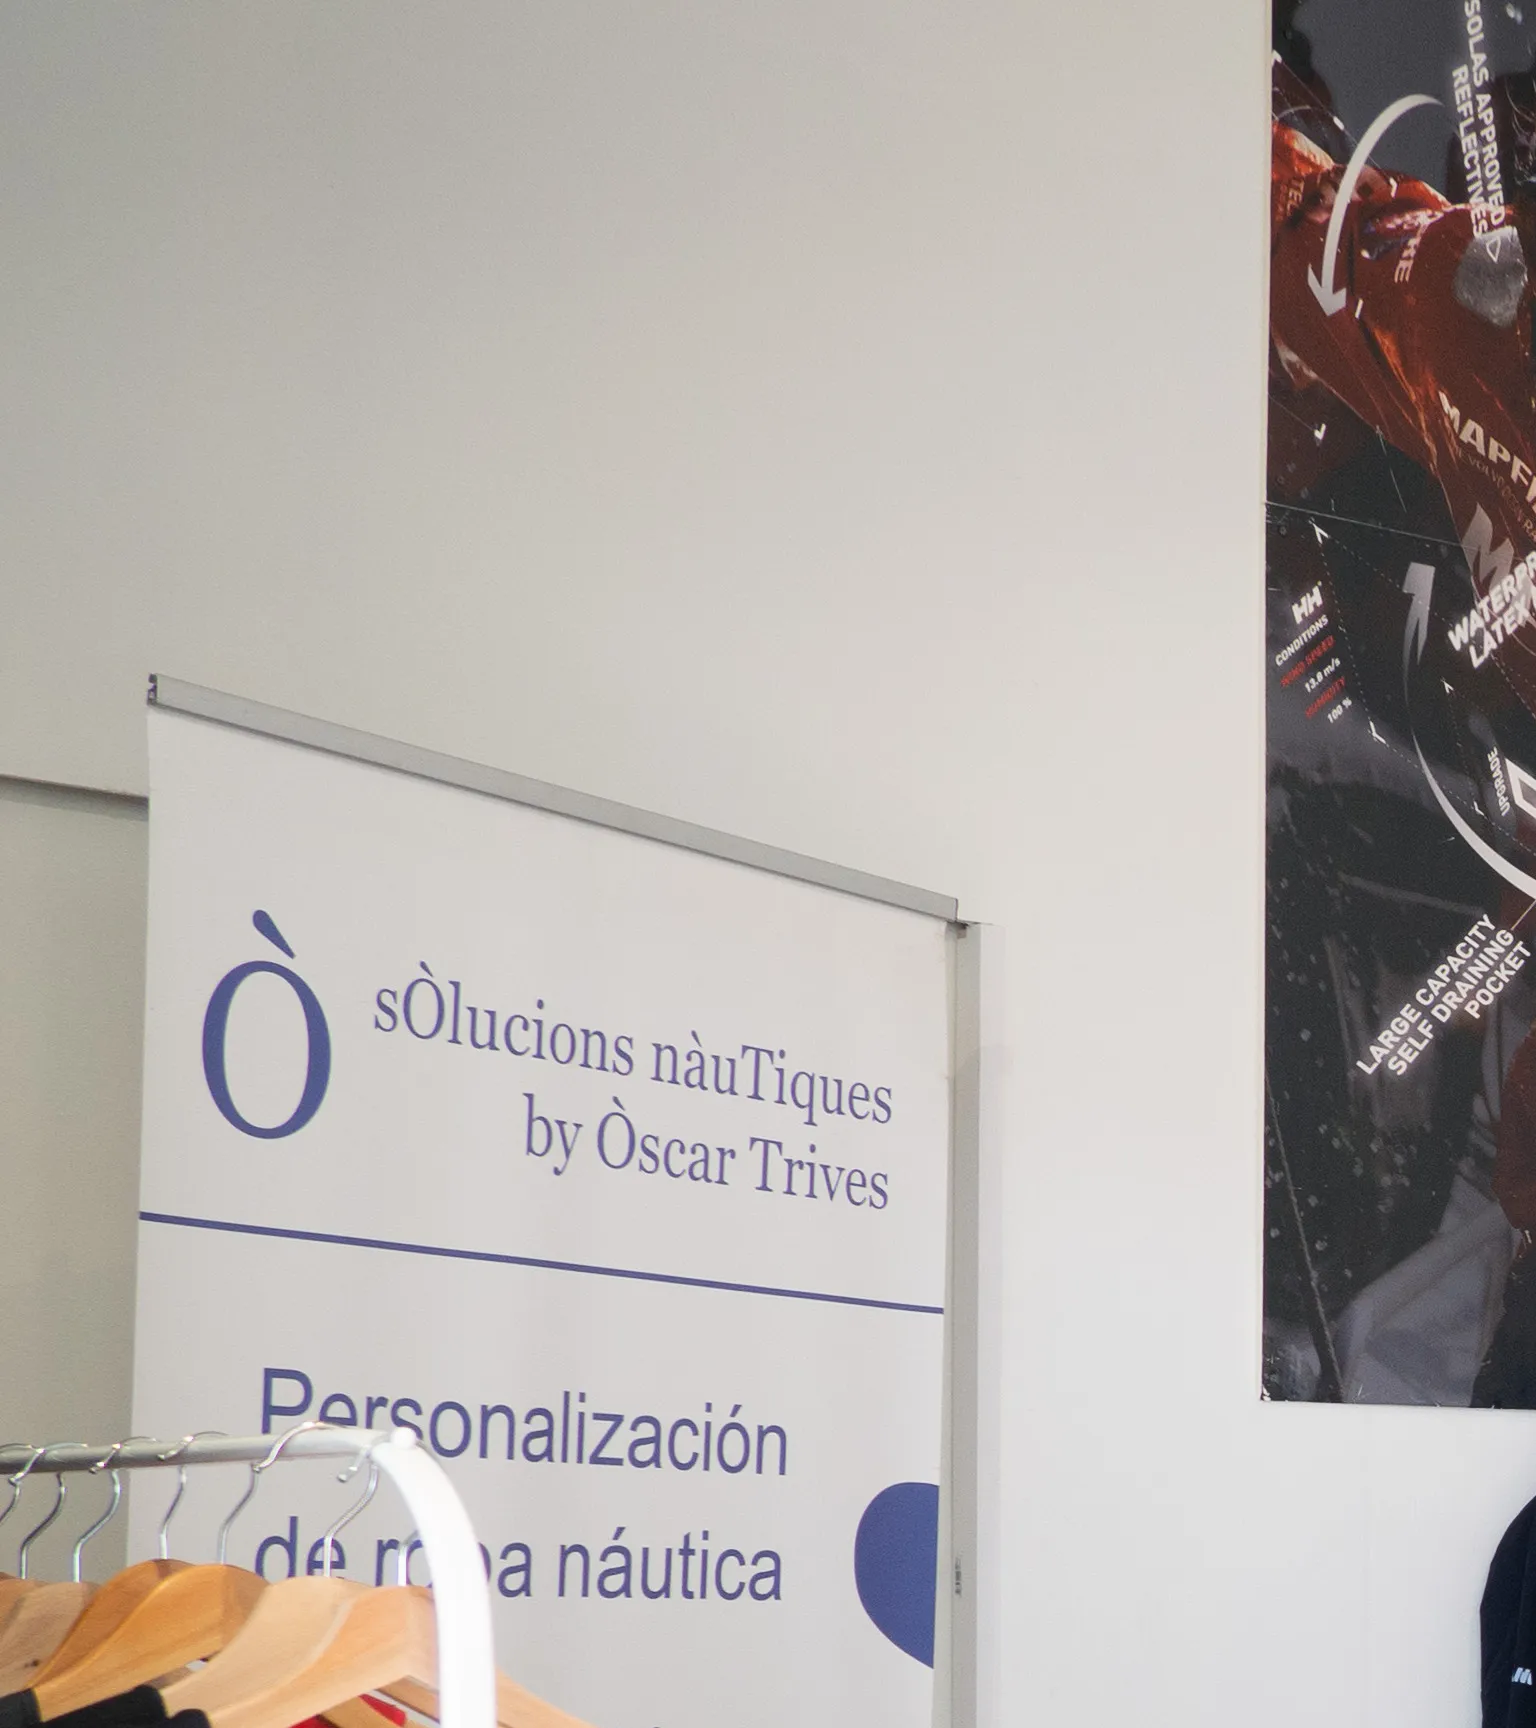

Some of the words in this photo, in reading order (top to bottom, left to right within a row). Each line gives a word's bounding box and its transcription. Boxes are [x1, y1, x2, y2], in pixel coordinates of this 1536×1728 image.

[1464, 0, 1490, 88] SOLAS
[1452, 64, 1489, 239] REFLECTIVES
[1476, 93, 1506, 229] APPROVED
[1275, 614, 1329, 667] CONDITIONS
[1469, 601, 1530, 670] LATEX
[1487, 746, 1511, 817] UPGRADE
[1356, 1003, 1422, 1075] LARGE
[1415, 913, 1496, 1007] CAPACITY
[1387, 1020, 1437, 1076] SELF
[1430, 928, 1515, 1023] DRAINING
[1464, 940, 1532, 1020] POCKET
[373, 961, 635, 1077] sÒlucions
[650, 1030, 894, 1127] nàuTiques
[523, 1093, 583, 1177] by
[596, 1096, 736, 1187] Òscar
[748, 1137, 890, 1212] Trives
[254, 1517, 346, 1579] de
[559, 1527, 783, 1602] náutica
